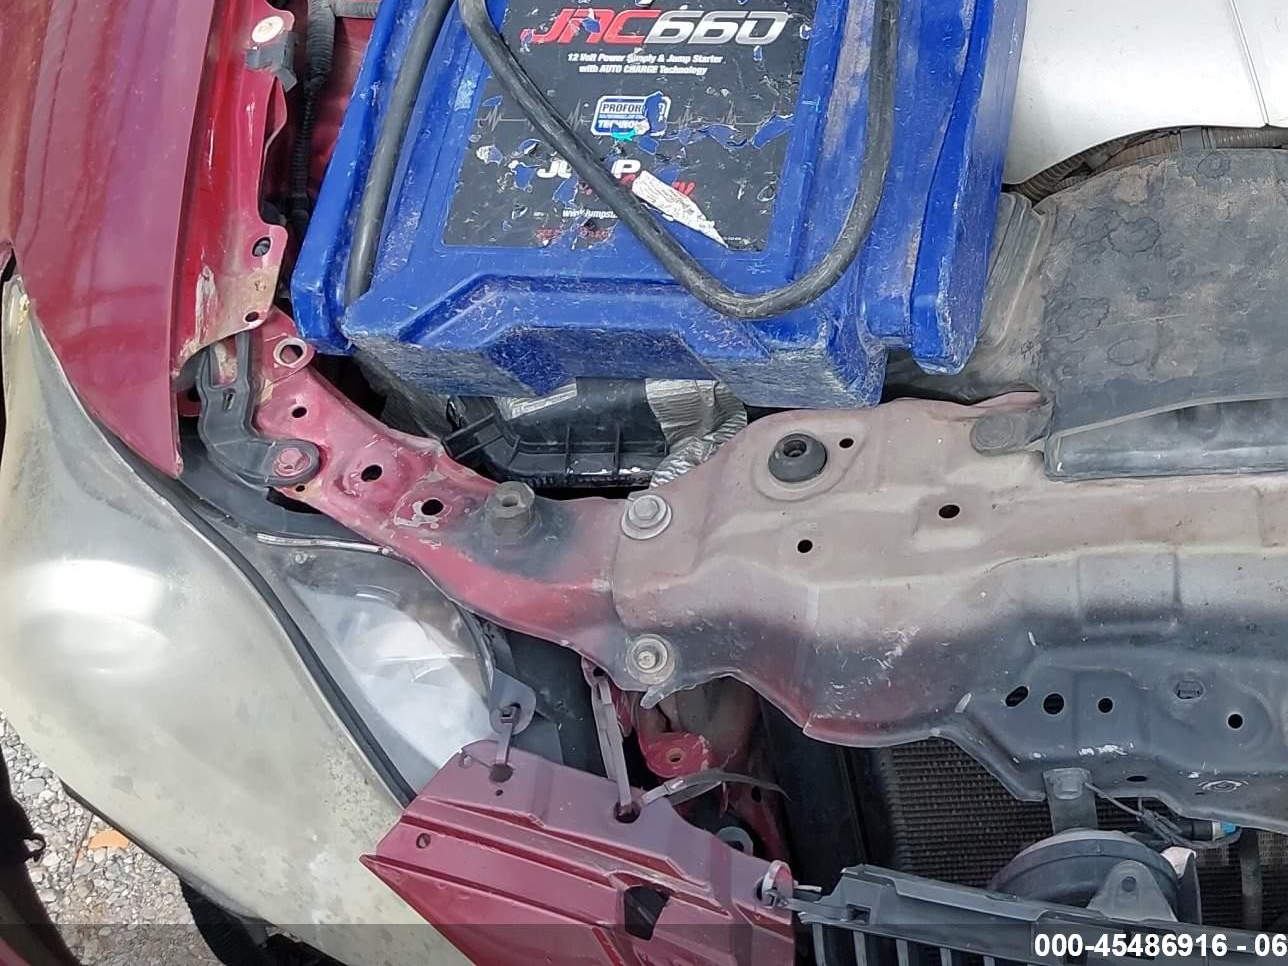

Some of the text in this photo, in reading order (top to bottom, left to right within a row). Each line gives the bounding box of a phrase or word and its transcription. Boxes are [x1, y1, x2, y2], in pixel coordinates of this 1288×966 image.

[567, 53, 578, 62] 12
[579, 53, 597, 62] Volt
[598, 54, 626, 62] Power
[657, 54, 666, 63] &
[666, 54, 691, 64] Jump
[692, 54, 724, 64] Starter
[578, 64, 708, 76] with AUTO CHARGE Technology
